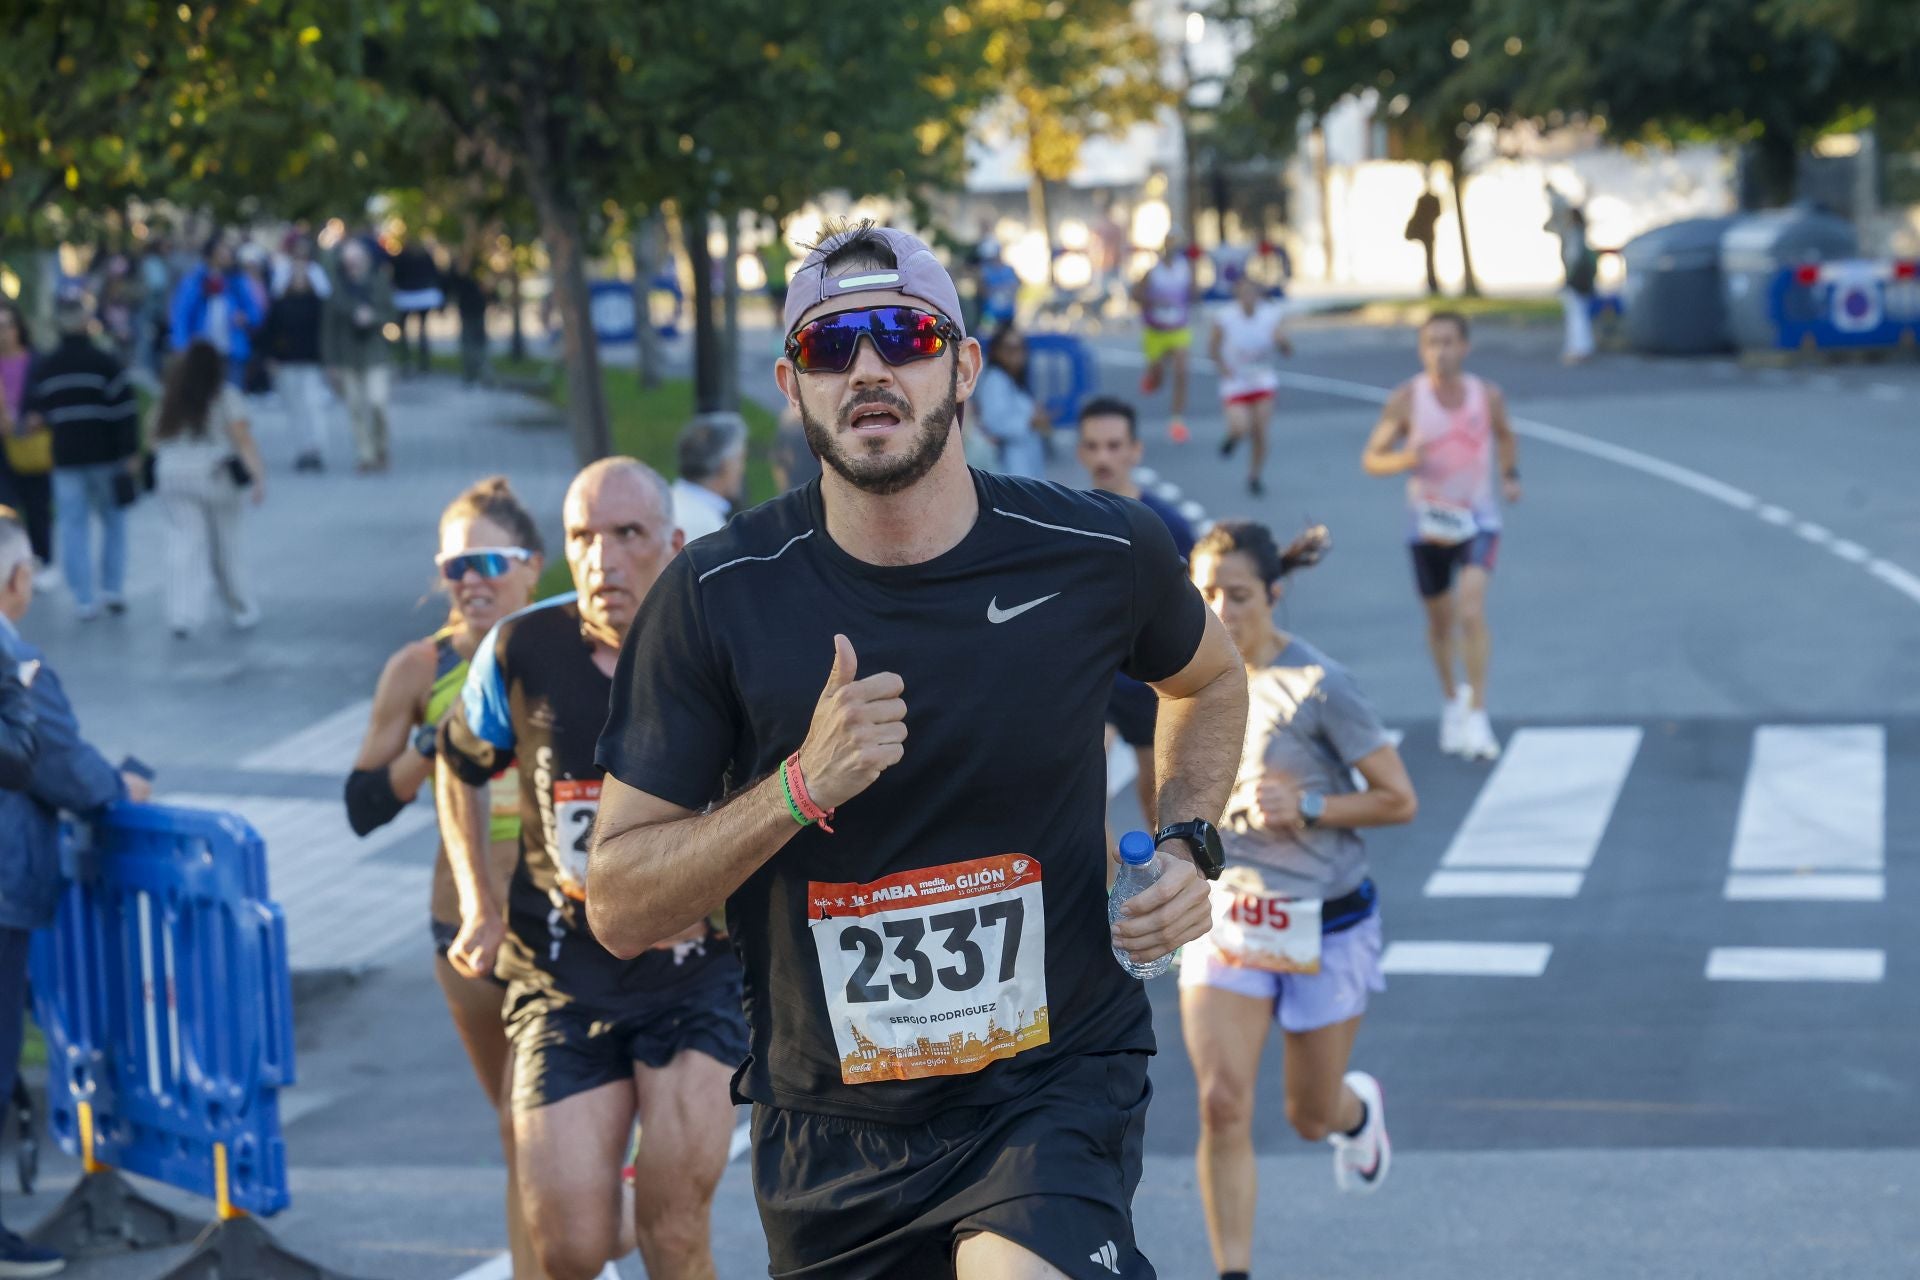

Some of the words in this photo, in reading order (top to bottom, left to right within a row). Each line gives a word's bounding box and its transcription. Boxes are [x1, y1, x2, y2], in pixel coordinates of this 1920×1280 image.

[919, 877, 946, 889] media
[956, 868, 1005, 889] GIJÓN
[873, 884, 918, 902] MBA
[920, 883, 956, 896] maratón
[839, 897, 1025, 1003] 2337
[889, 1016, 928, 1025] SERGIO
[930, 1003, 997, 1023] RODRIGUEZ
